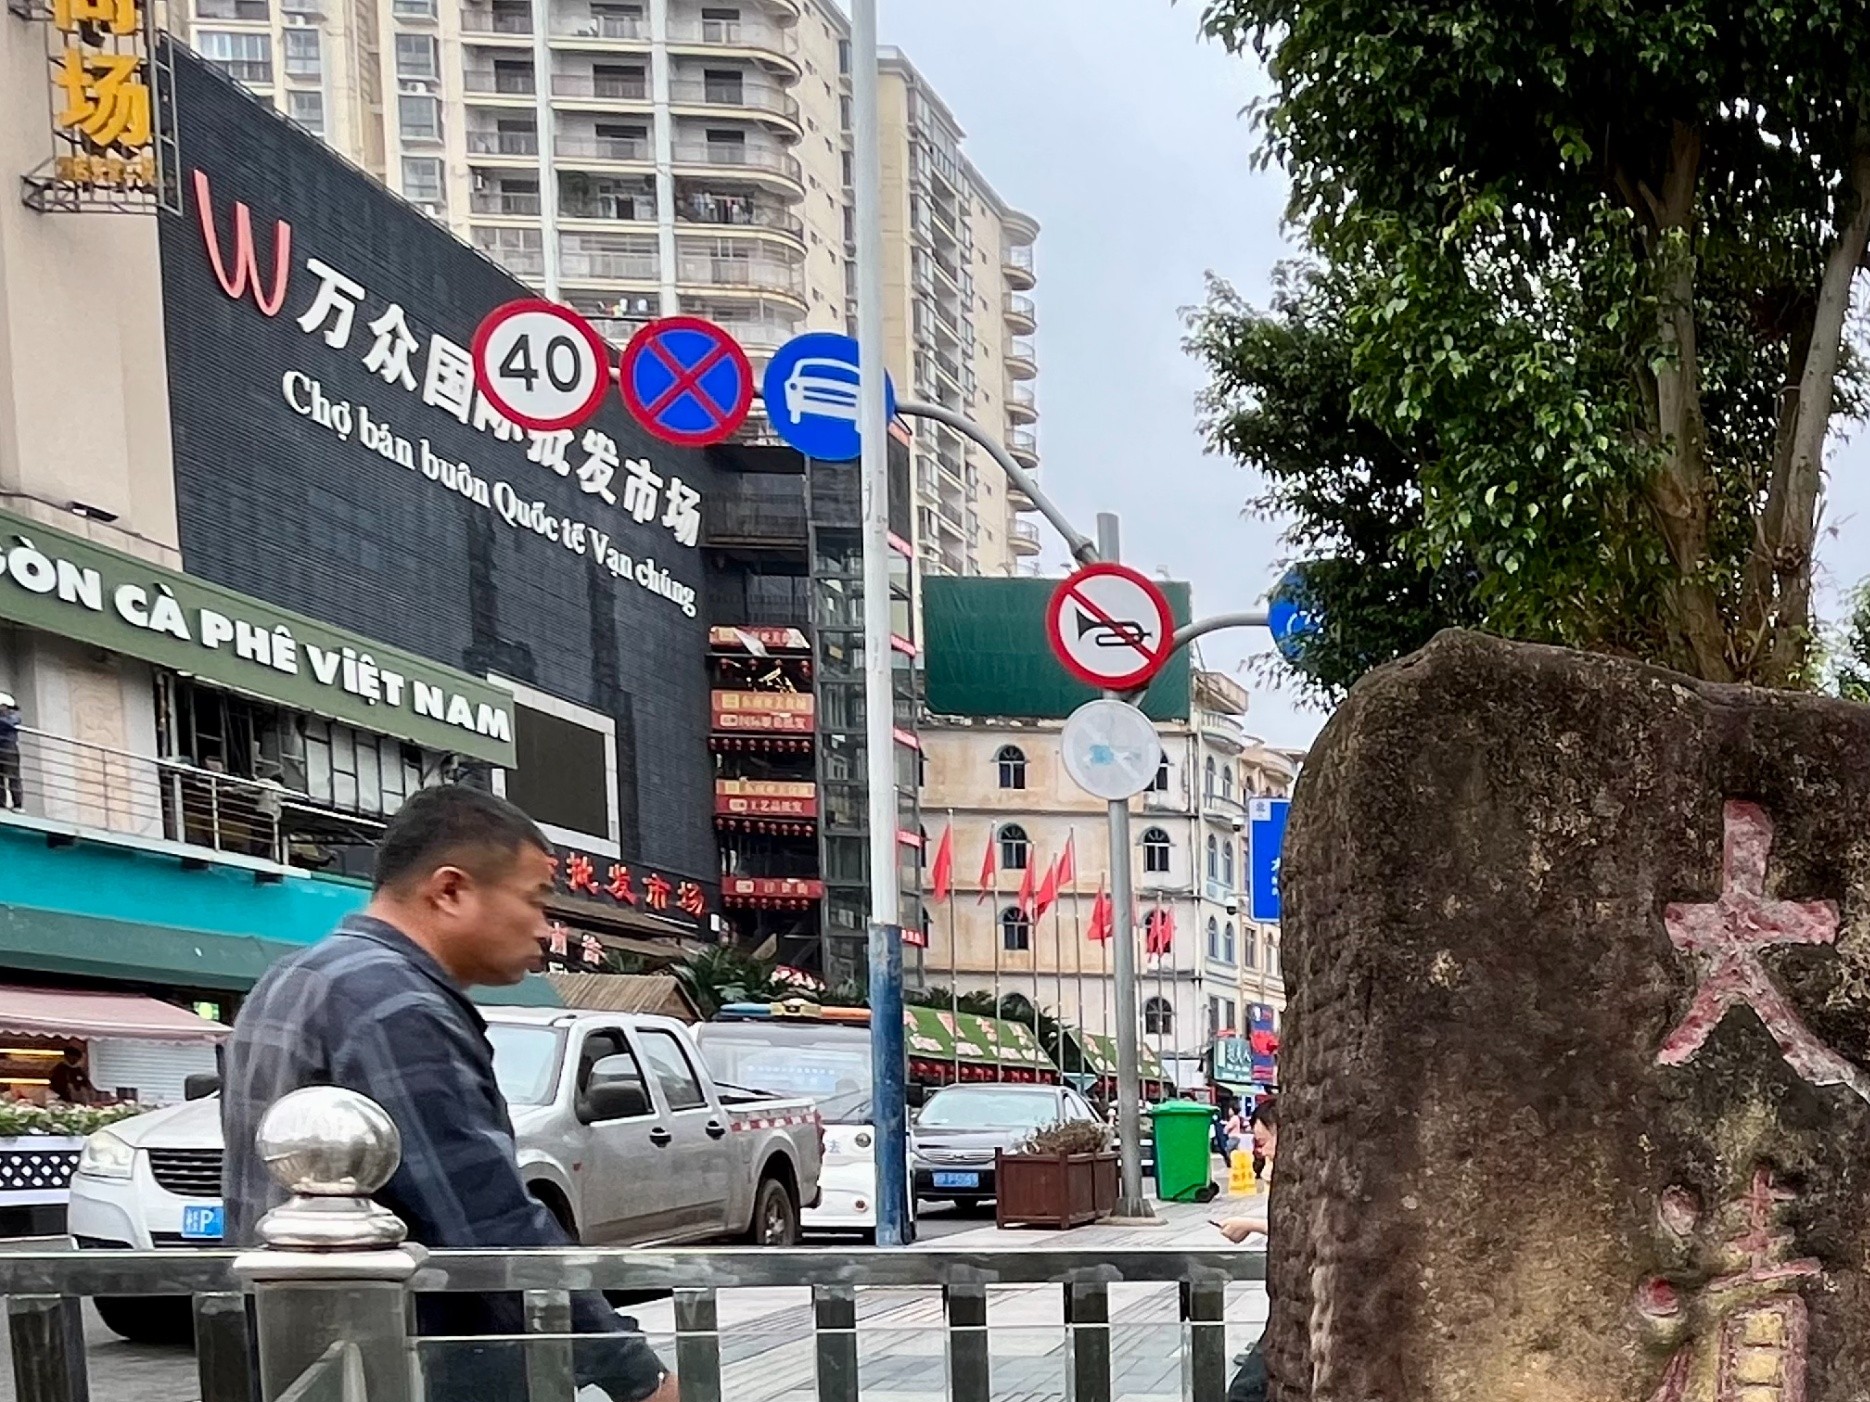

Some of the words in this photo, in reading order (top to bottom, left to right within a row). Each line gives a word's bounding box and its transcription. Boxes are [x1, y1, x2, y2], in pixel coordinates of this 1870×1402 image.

[296, 257, 701, 547] 万众国批发市场
[498, 334, 582, 393] 40
[283, 370, 353, 441] Chợ
[358, 406, 415, 470] bán
[420, 438, 491, 508] buôn
[493, 482, 559, 542] Quốc
[587, 527, 634, 580] Vạn
[0, 535, 103, 612] ÒN
[115, 582, 191, 641] CÀ
[200, 608, 298, 675] PHÊ
[413, 680, 512, 743] NAM
